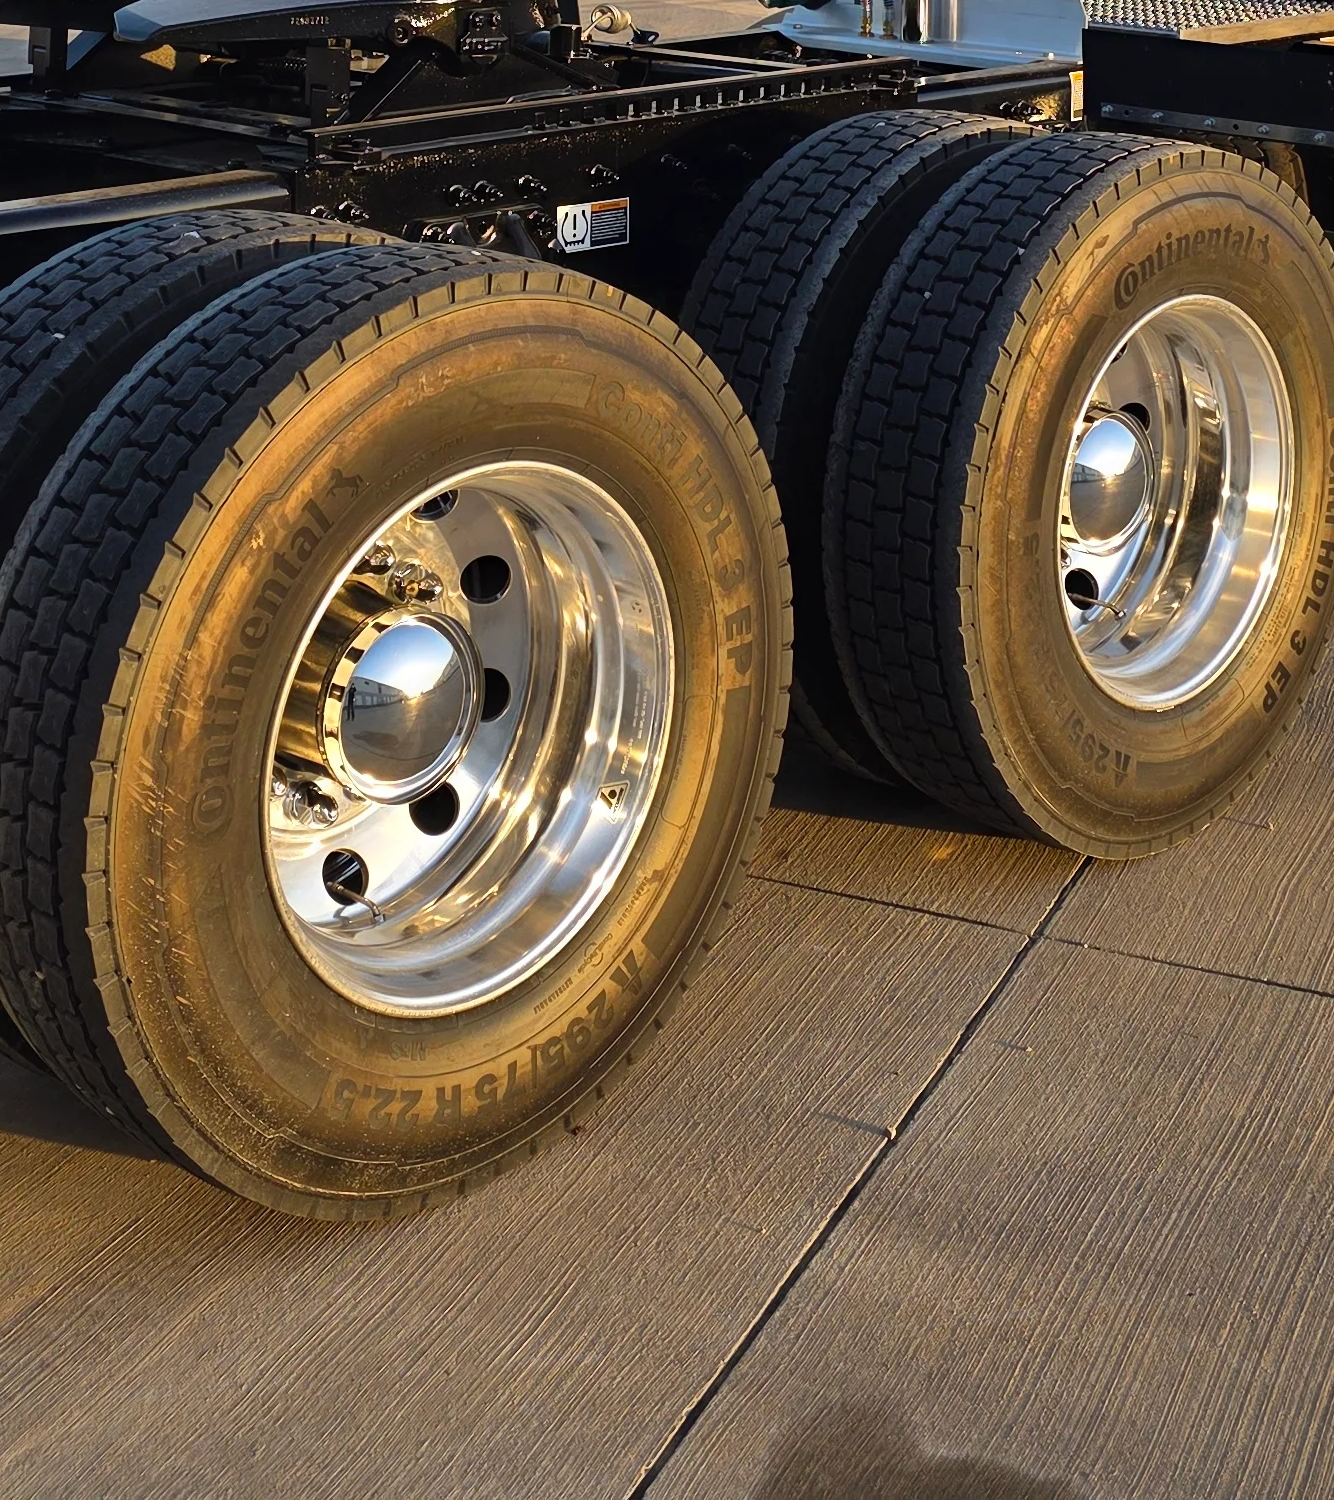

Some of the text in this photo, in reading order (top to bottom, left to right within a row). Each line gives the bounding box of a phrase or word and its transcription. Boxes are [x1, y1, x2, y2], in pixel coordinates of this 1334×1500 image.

[1114, 223, 1256, 311] Continental
[597, 381, 752, 676] Conti HDL 3 EP
[190, 497, 335, 835] Continental
[1262, 660, 1292, 715] EP
[1289, 629, 1307, 657] 3
[327, 988, 616, 1130] 295/75 R 22.5
